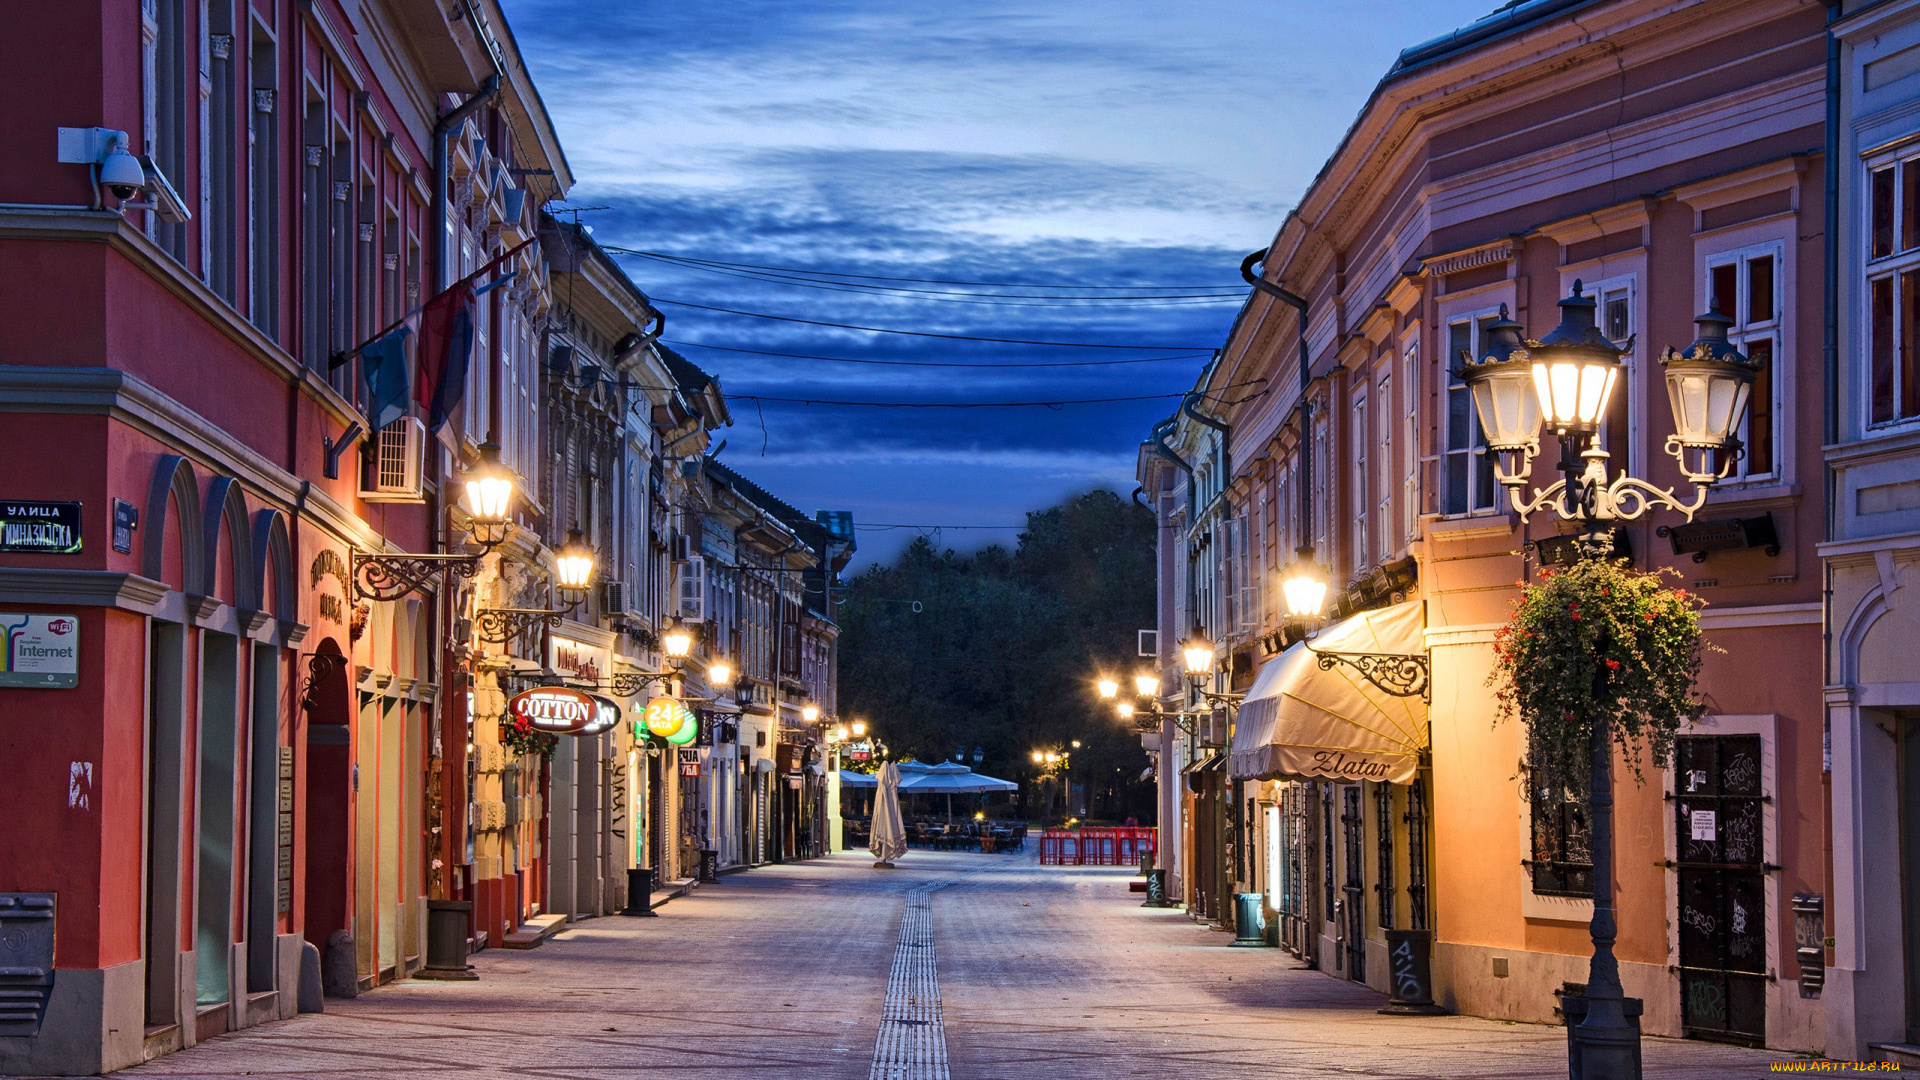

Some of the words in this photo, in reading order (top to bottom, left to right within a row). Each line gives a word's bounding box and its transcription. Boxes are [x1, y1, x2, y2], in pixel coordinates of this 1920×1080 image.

[7, 506, 60, 517] УЛИЦА
[19, 645, 73, 657] Internet
[517, 698, 590, 721] COTTON
[649, 703, 672, 720] 24
[649, 721, 672, 729] SATA
[1311, 751, 1391, 776] Zlatar
